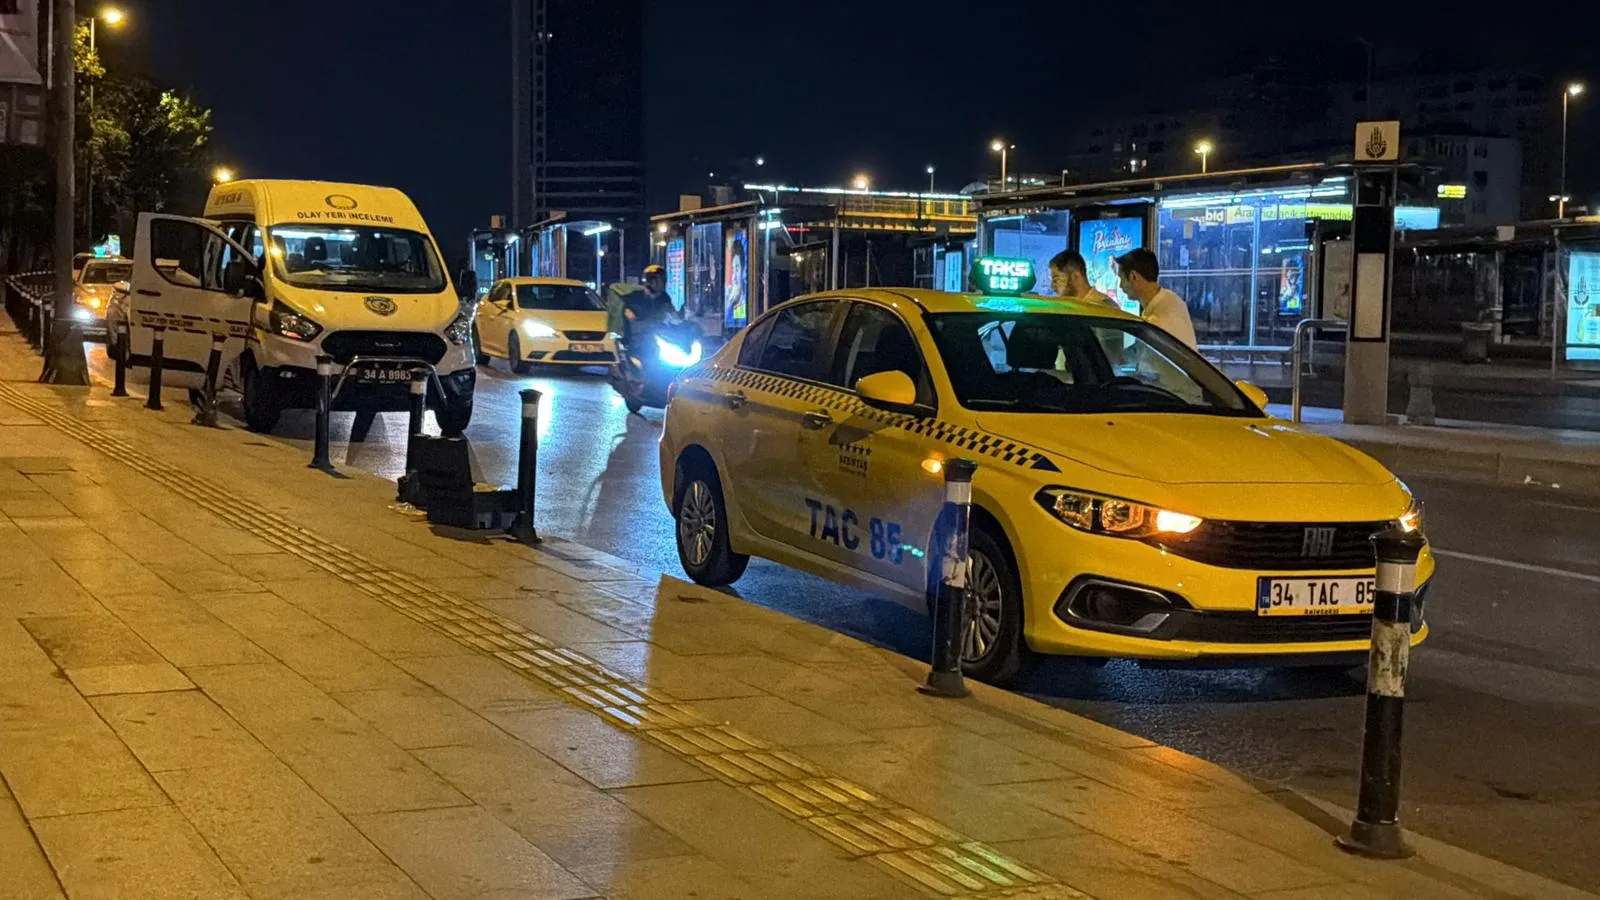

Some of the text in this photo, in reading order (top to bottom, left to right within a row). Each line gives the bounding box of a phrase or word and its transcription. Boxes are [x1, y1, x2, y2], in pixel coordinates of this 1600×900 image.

[297, 211, 320, 219] OLAY
[364, 370, 376, 379] 34
[378, 370, 386, 379] A
[804, 497, 903, 565] TAC 85
[1301, 527, 1337, 557] FIAT
[1272, 581, 1376, 606] 34 TAC 85
